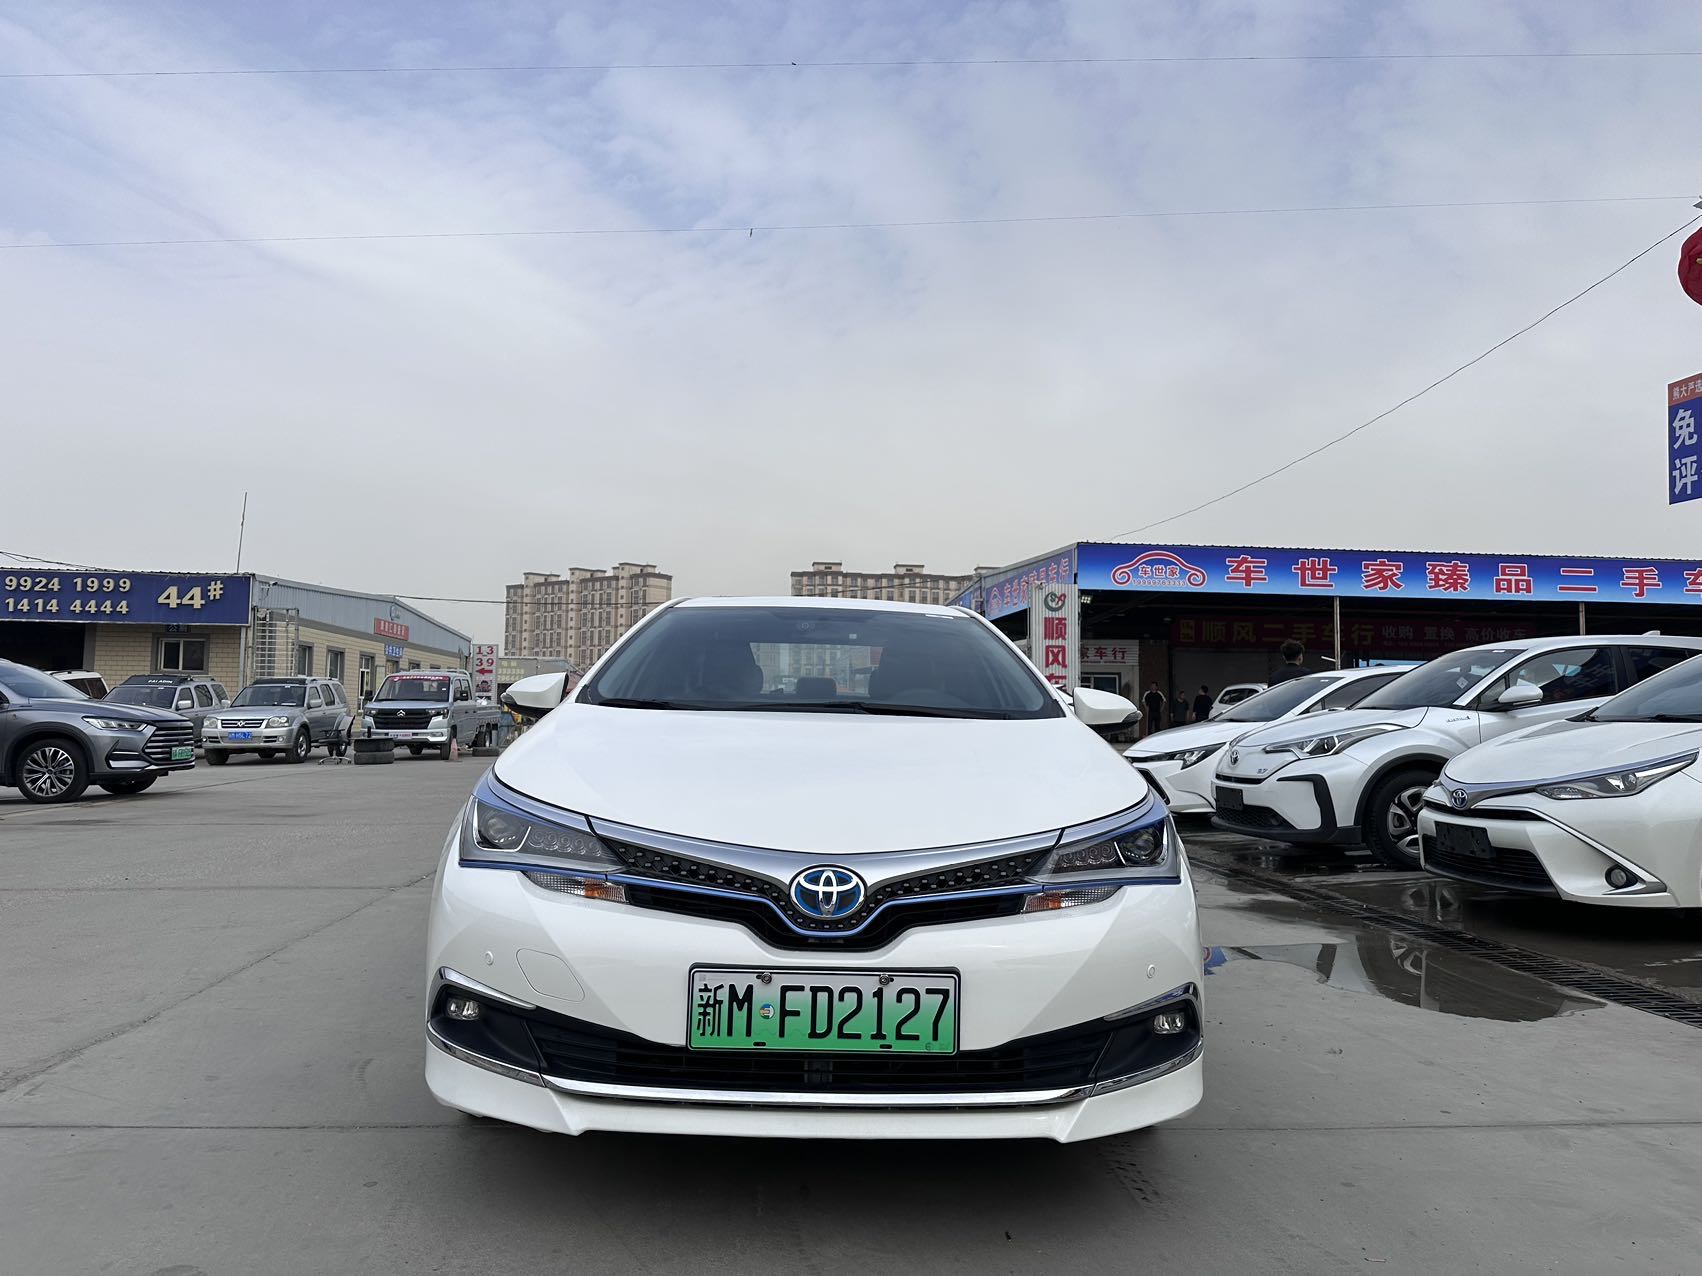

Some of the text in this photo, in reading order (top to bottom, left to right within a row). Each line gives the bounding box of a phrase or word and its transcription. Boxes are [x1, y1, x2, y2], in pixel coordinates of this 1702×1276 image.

[1138, 564, 1180, 579] 车世家
[5, 576, 132, 593] 9924 1999
[5, 597, 129, 615] 1414 4444
[696, 983, 951, 1042] 新M FD2127
